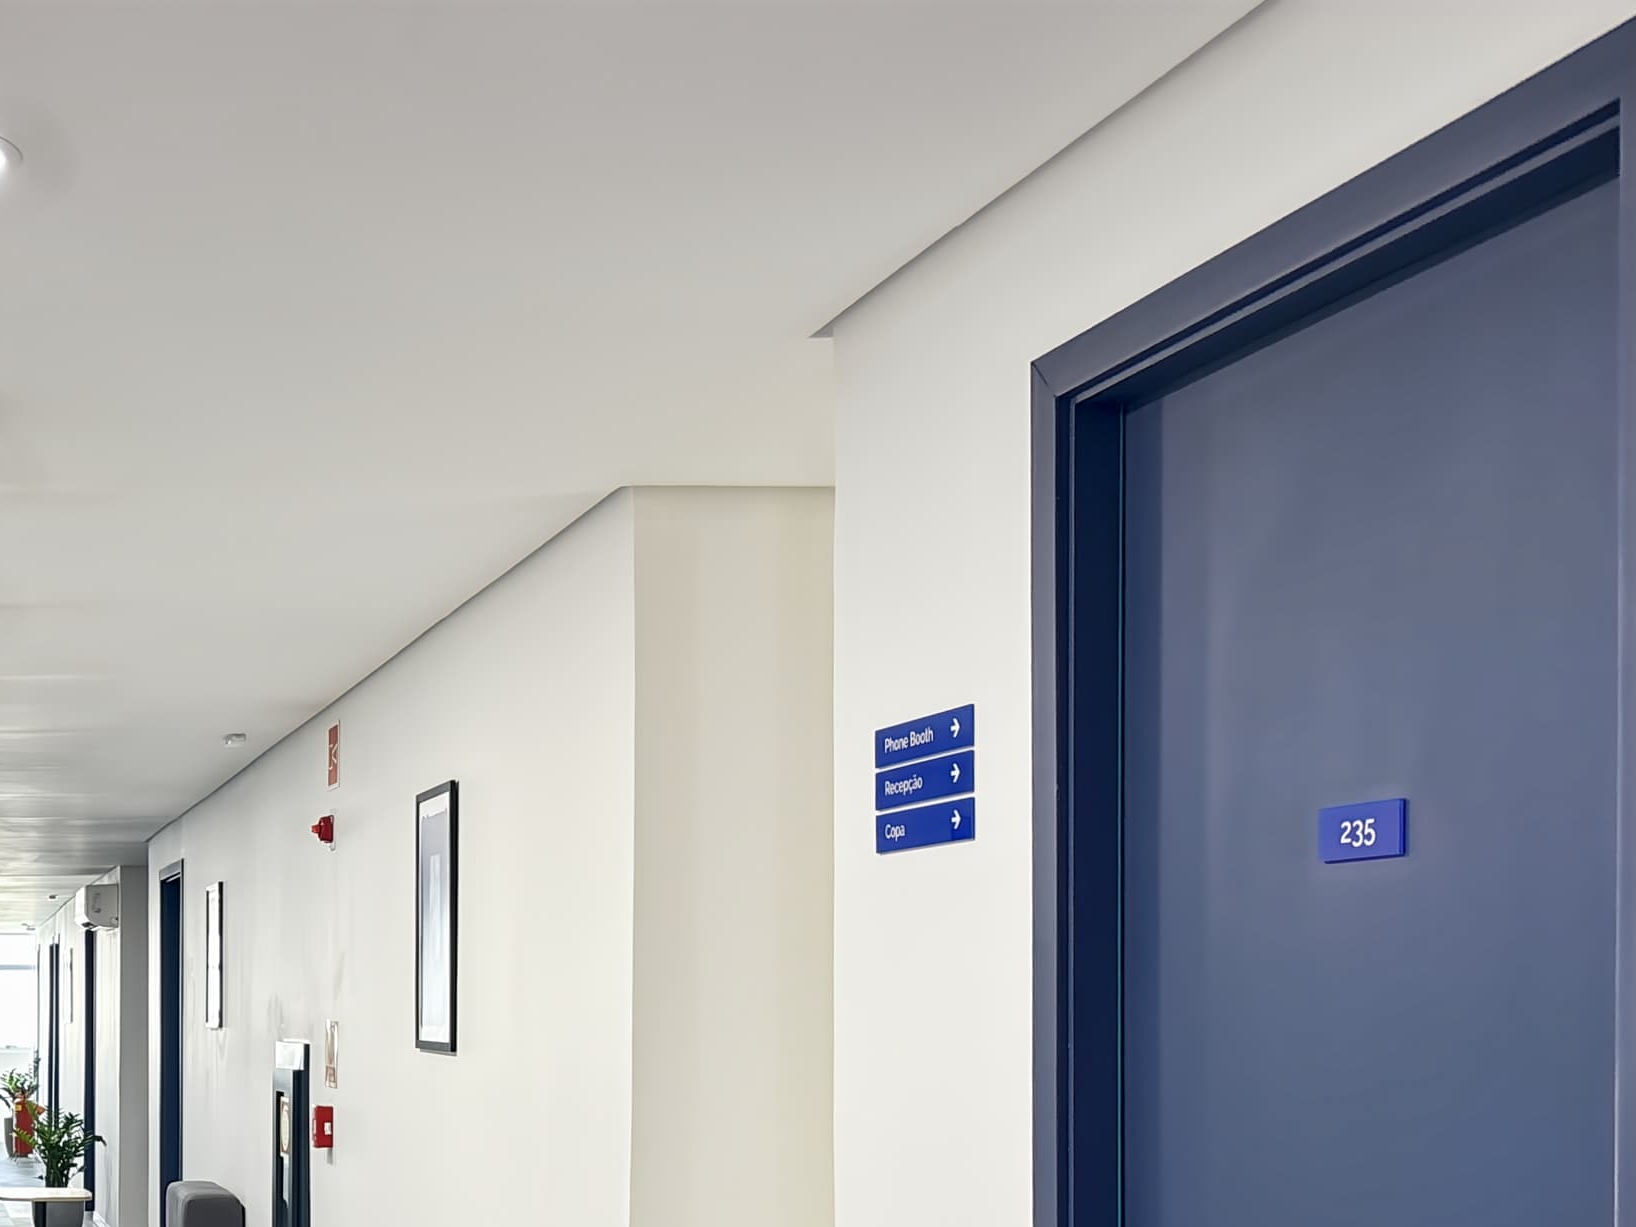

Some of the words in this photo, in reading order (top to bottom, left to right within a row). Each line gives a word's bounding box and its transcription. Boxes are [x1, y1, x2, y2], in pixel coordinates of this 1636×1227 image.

[884, 736, 909, 754] Phone
[910, 727, 934, 748] Booth
[884, 774, 923, 796] Recepção
[884, 824, 906, 842] Copa
[1340, 818, 1376, 848] 235
